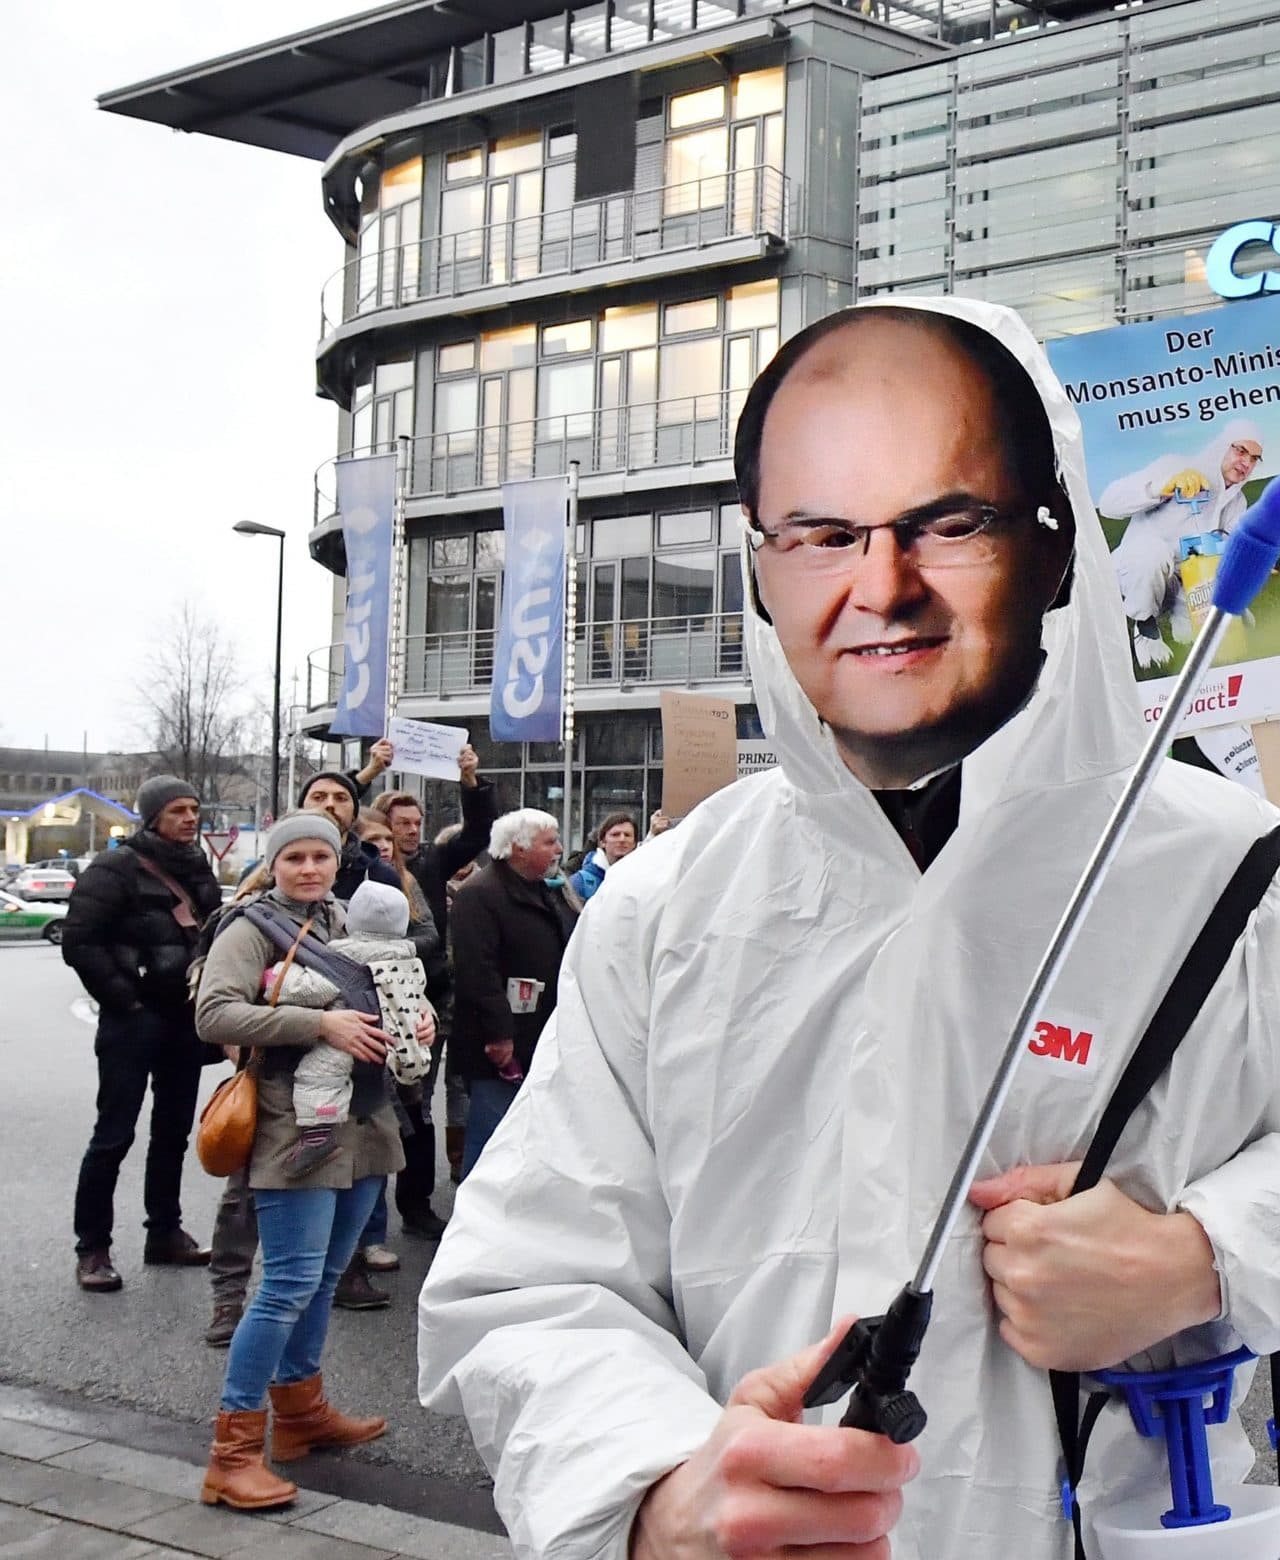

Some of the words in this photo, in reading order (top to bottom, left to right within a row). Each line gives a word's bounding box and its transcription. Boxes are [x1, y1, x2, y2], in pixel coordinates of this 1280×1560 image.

[1166, 326, 1215, 355] Der
[1117, 401, 1190, 431] muss
[1143, 674, 1243, 722] caact!
[1200, 683, 1225, 695] olitik
[1028, 1021, 1094, 1066] 3M
